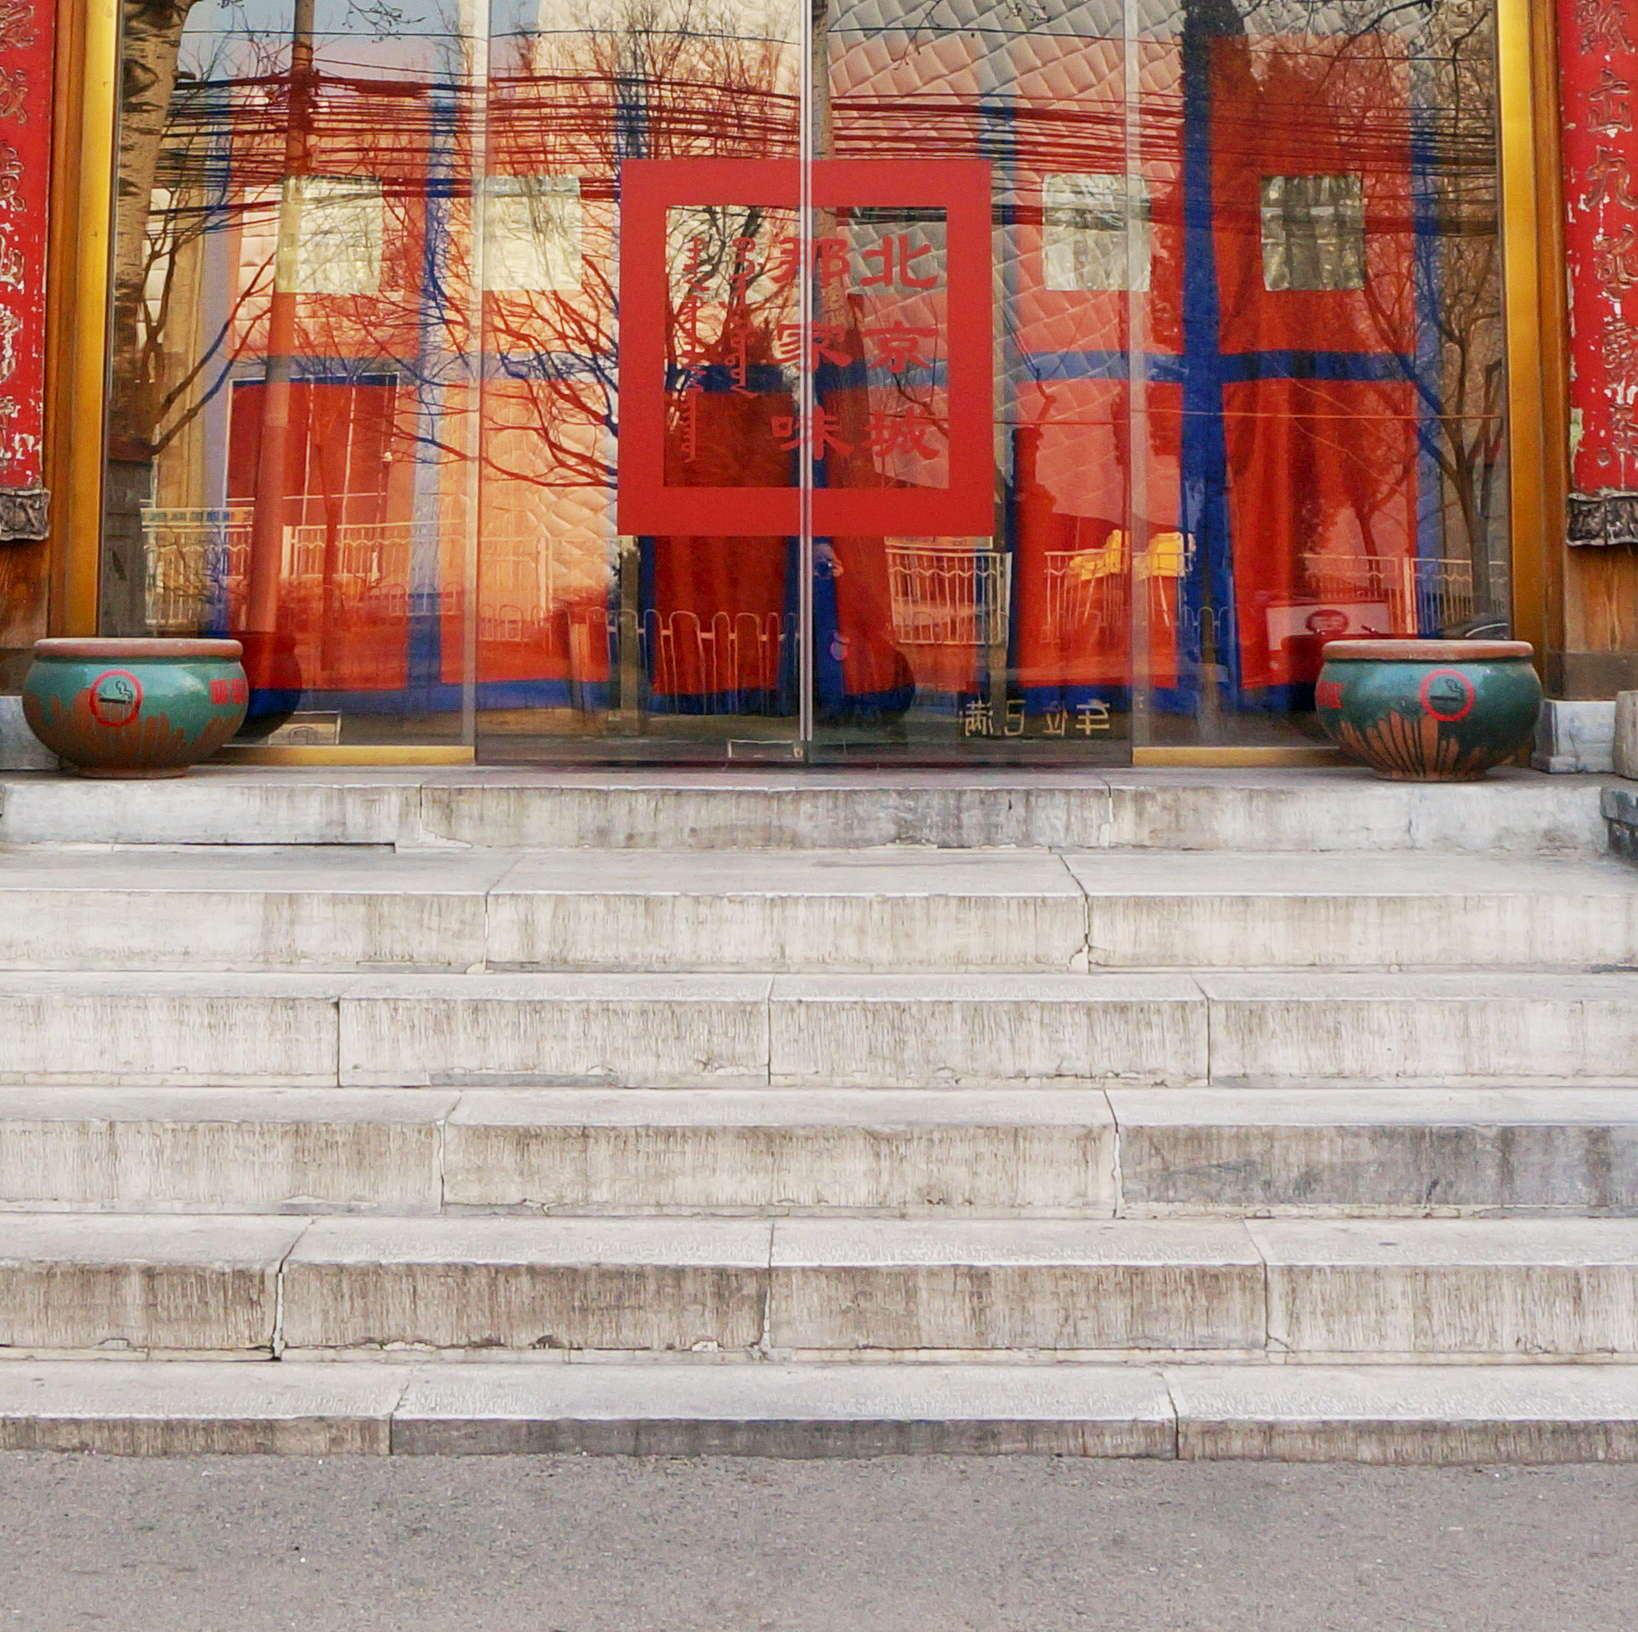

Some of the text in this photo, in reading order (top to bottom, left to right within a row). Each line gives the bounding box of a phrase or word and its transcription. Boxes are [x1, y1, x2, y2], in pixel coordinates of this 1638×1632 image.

[769, 236, 855, 461] 那家味
[859, 233, 941, 460] 北京城
